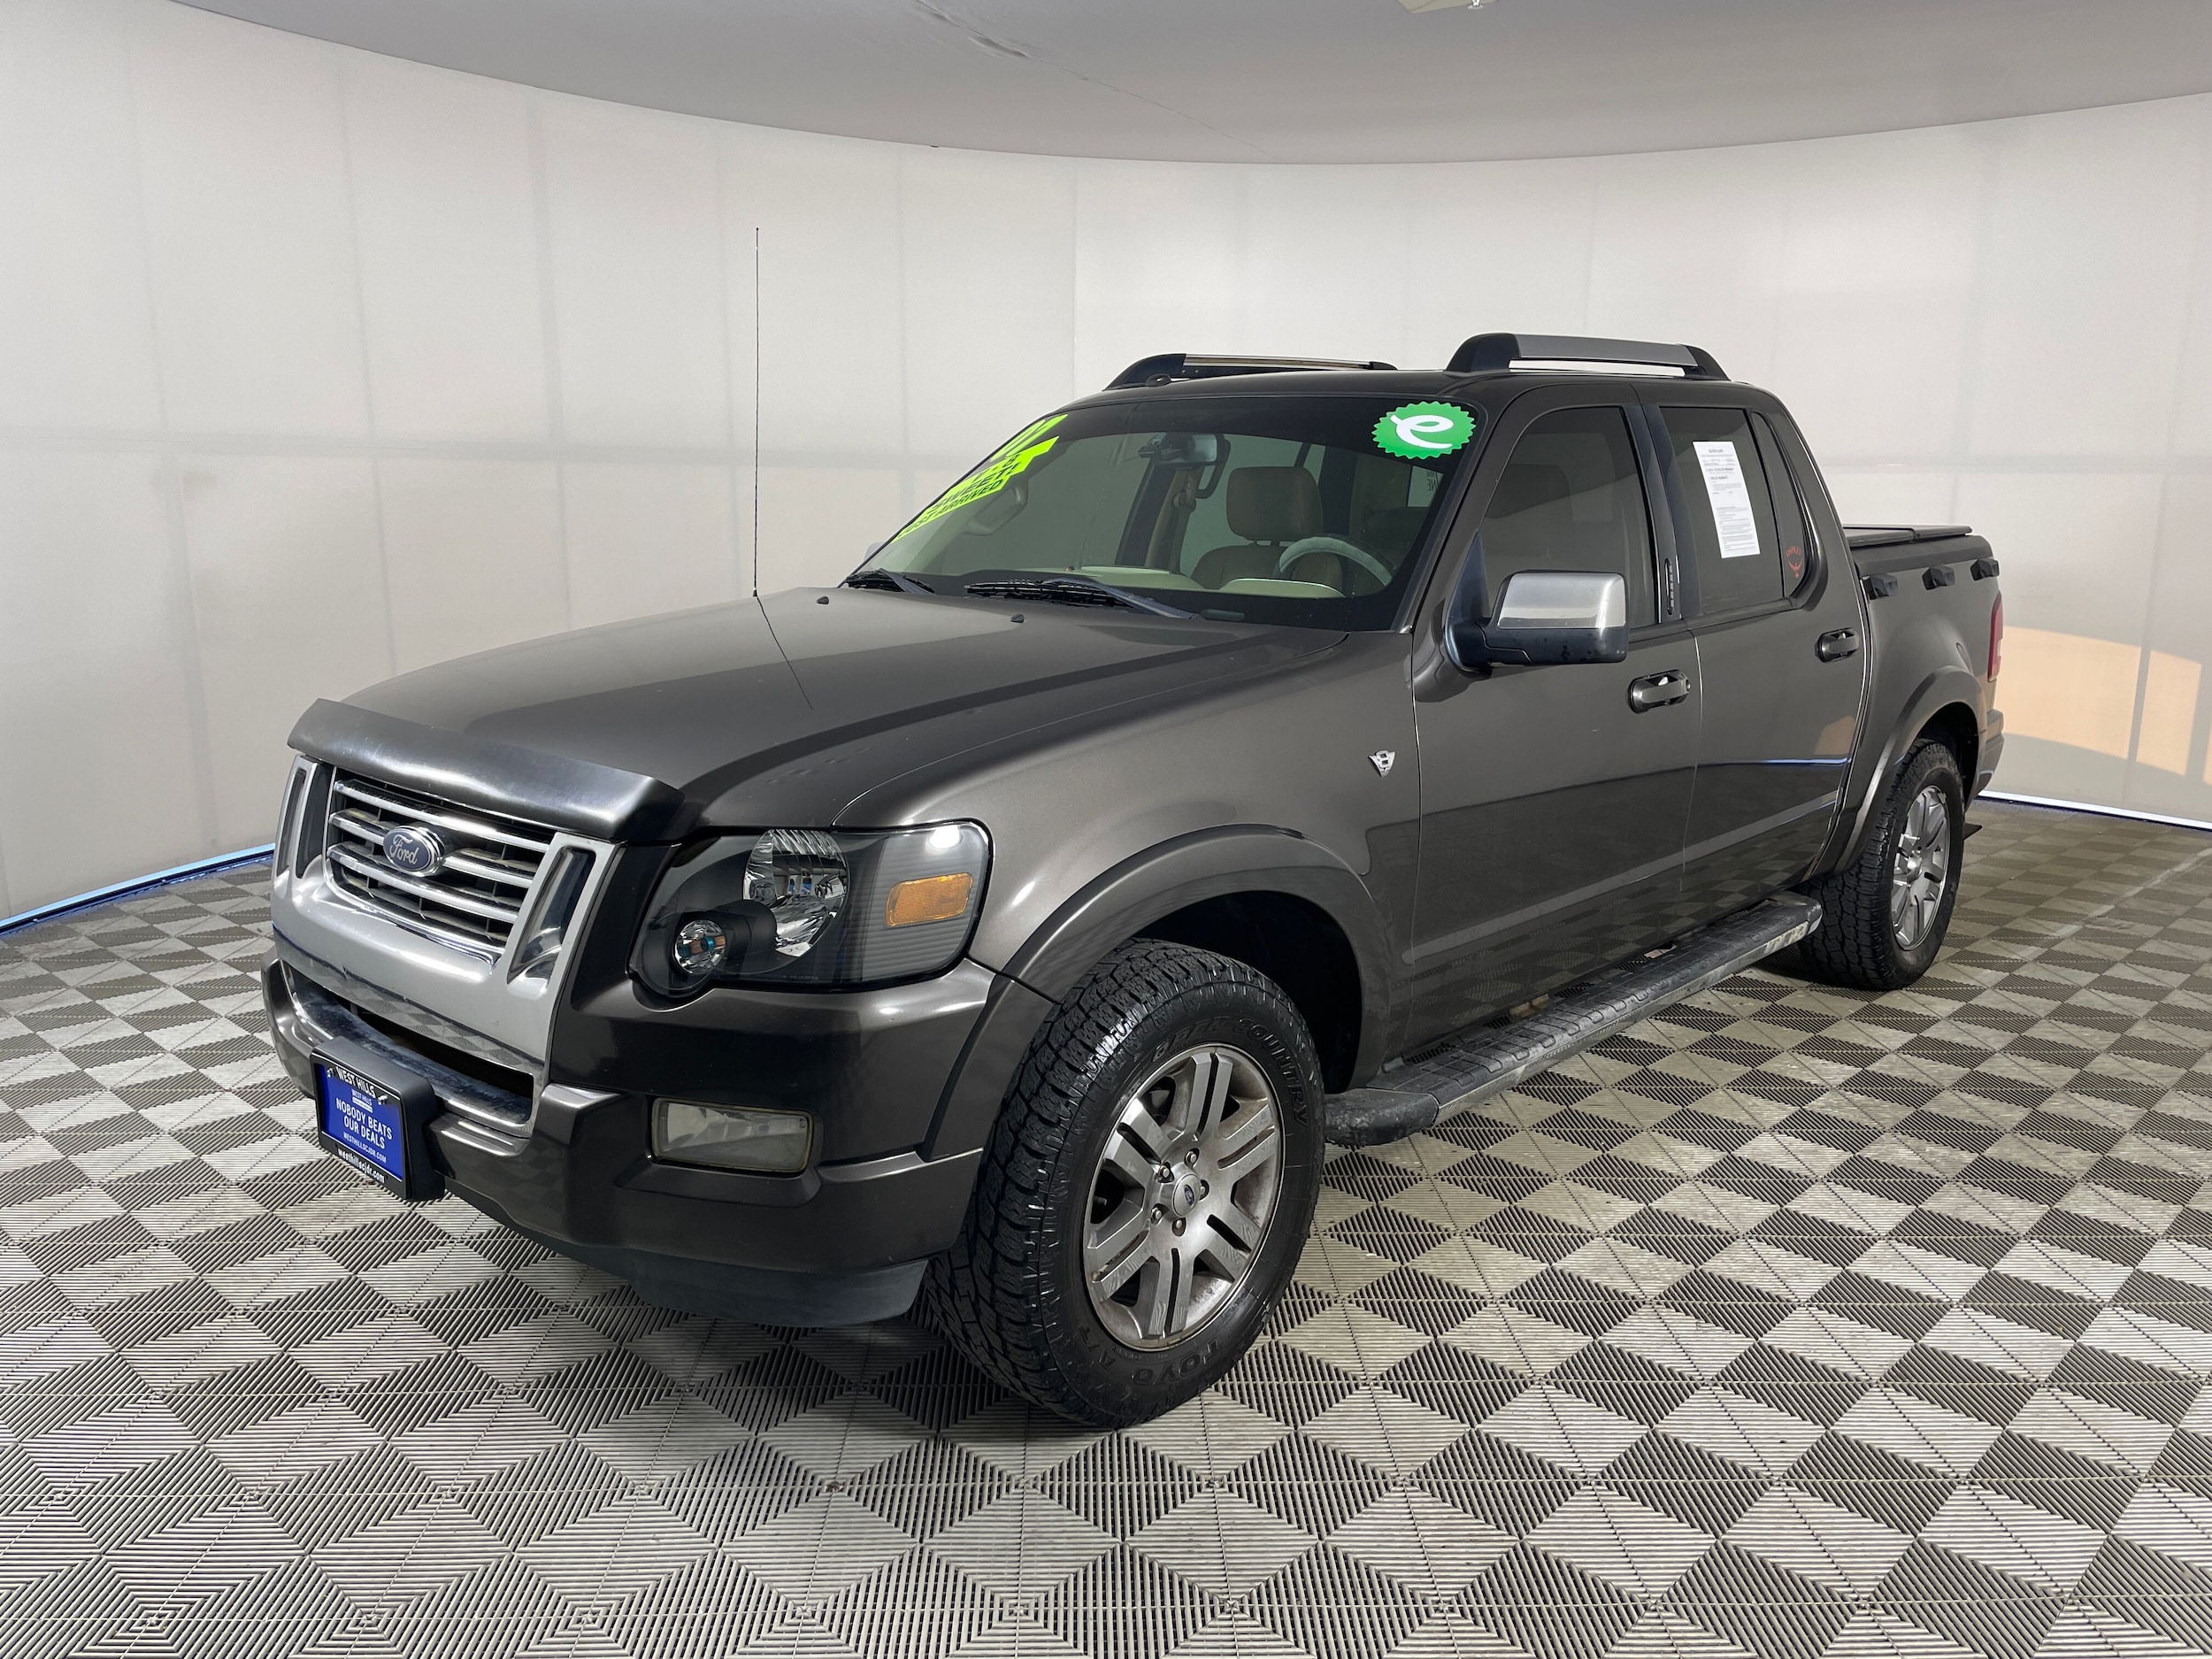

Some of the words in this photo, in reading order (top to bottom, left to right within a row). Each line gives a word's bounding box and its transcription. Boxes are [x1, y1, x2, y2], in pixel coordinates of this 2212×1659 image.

[926, 461, 1022, 515] SWEET!
[933, 479, 1003, 518] ARRIVED
[389, 833, 420, 865] Ford
[335, 1065, 356, 1087] WEST
[355, 1076, 376, 1099] HILLS
[1233, 1018, 1309, 1126] COUNTRY
[335, 1096, 366, 1126] NOBODY
[367, 1115, 393, 1141] BEATS
[343, 1115, 359, 1134] OUR
[360, 1125, 386, 1149] DEALS
[1131, 1331, 1219, 1386] TOYO
